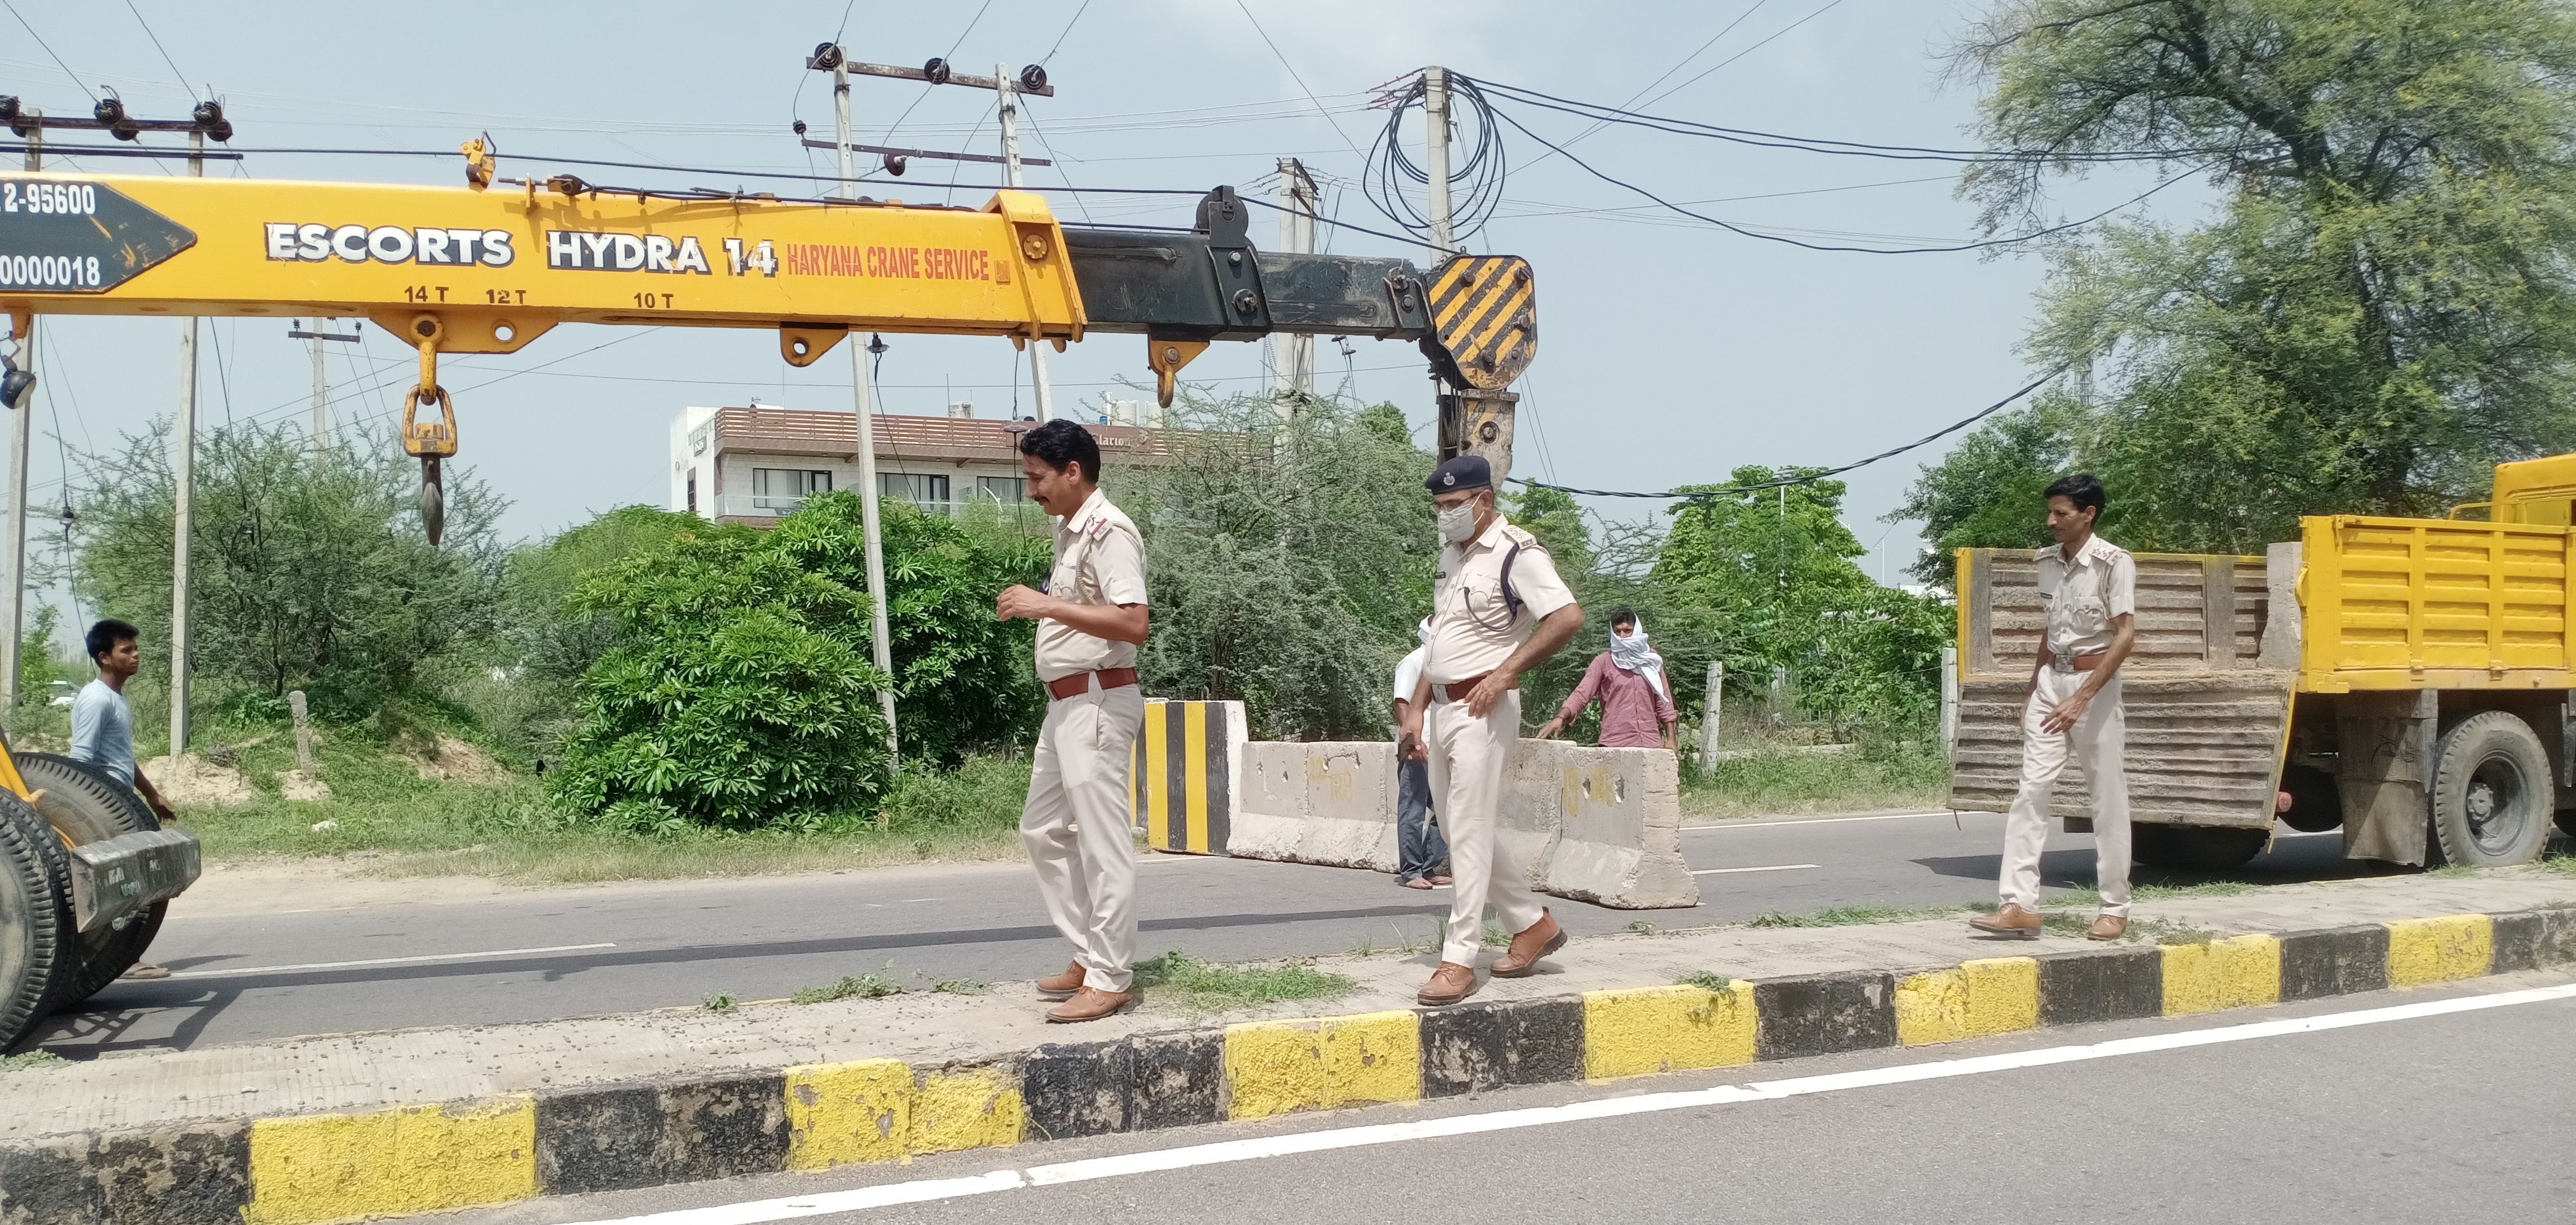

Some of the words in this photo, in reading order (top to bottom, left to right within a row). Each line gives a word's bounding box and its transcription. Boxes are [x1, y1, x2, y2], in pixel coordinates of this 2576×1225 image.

[0, 183, 95, 214] 2-95600
[264, 223, 515, 267] ESCORTS
[546, 230, 712, 275] HYDRA
[722, 237, 778, 277] 14
[787, 244, 863, 276] HARYANA
[867, 246, 920, 279] CRANE
[924, 248, 989, 281] SERVICE
[0, 255, 100, 286] 0000018
[405, 286, 428, 303] 14
[435, 286, 449, 303] T
[486, 289, 510, 304] 12
[515, 290, 527, 304] T
[634, 293, 655, 308] 10
[661, 293, 674, 308] T
